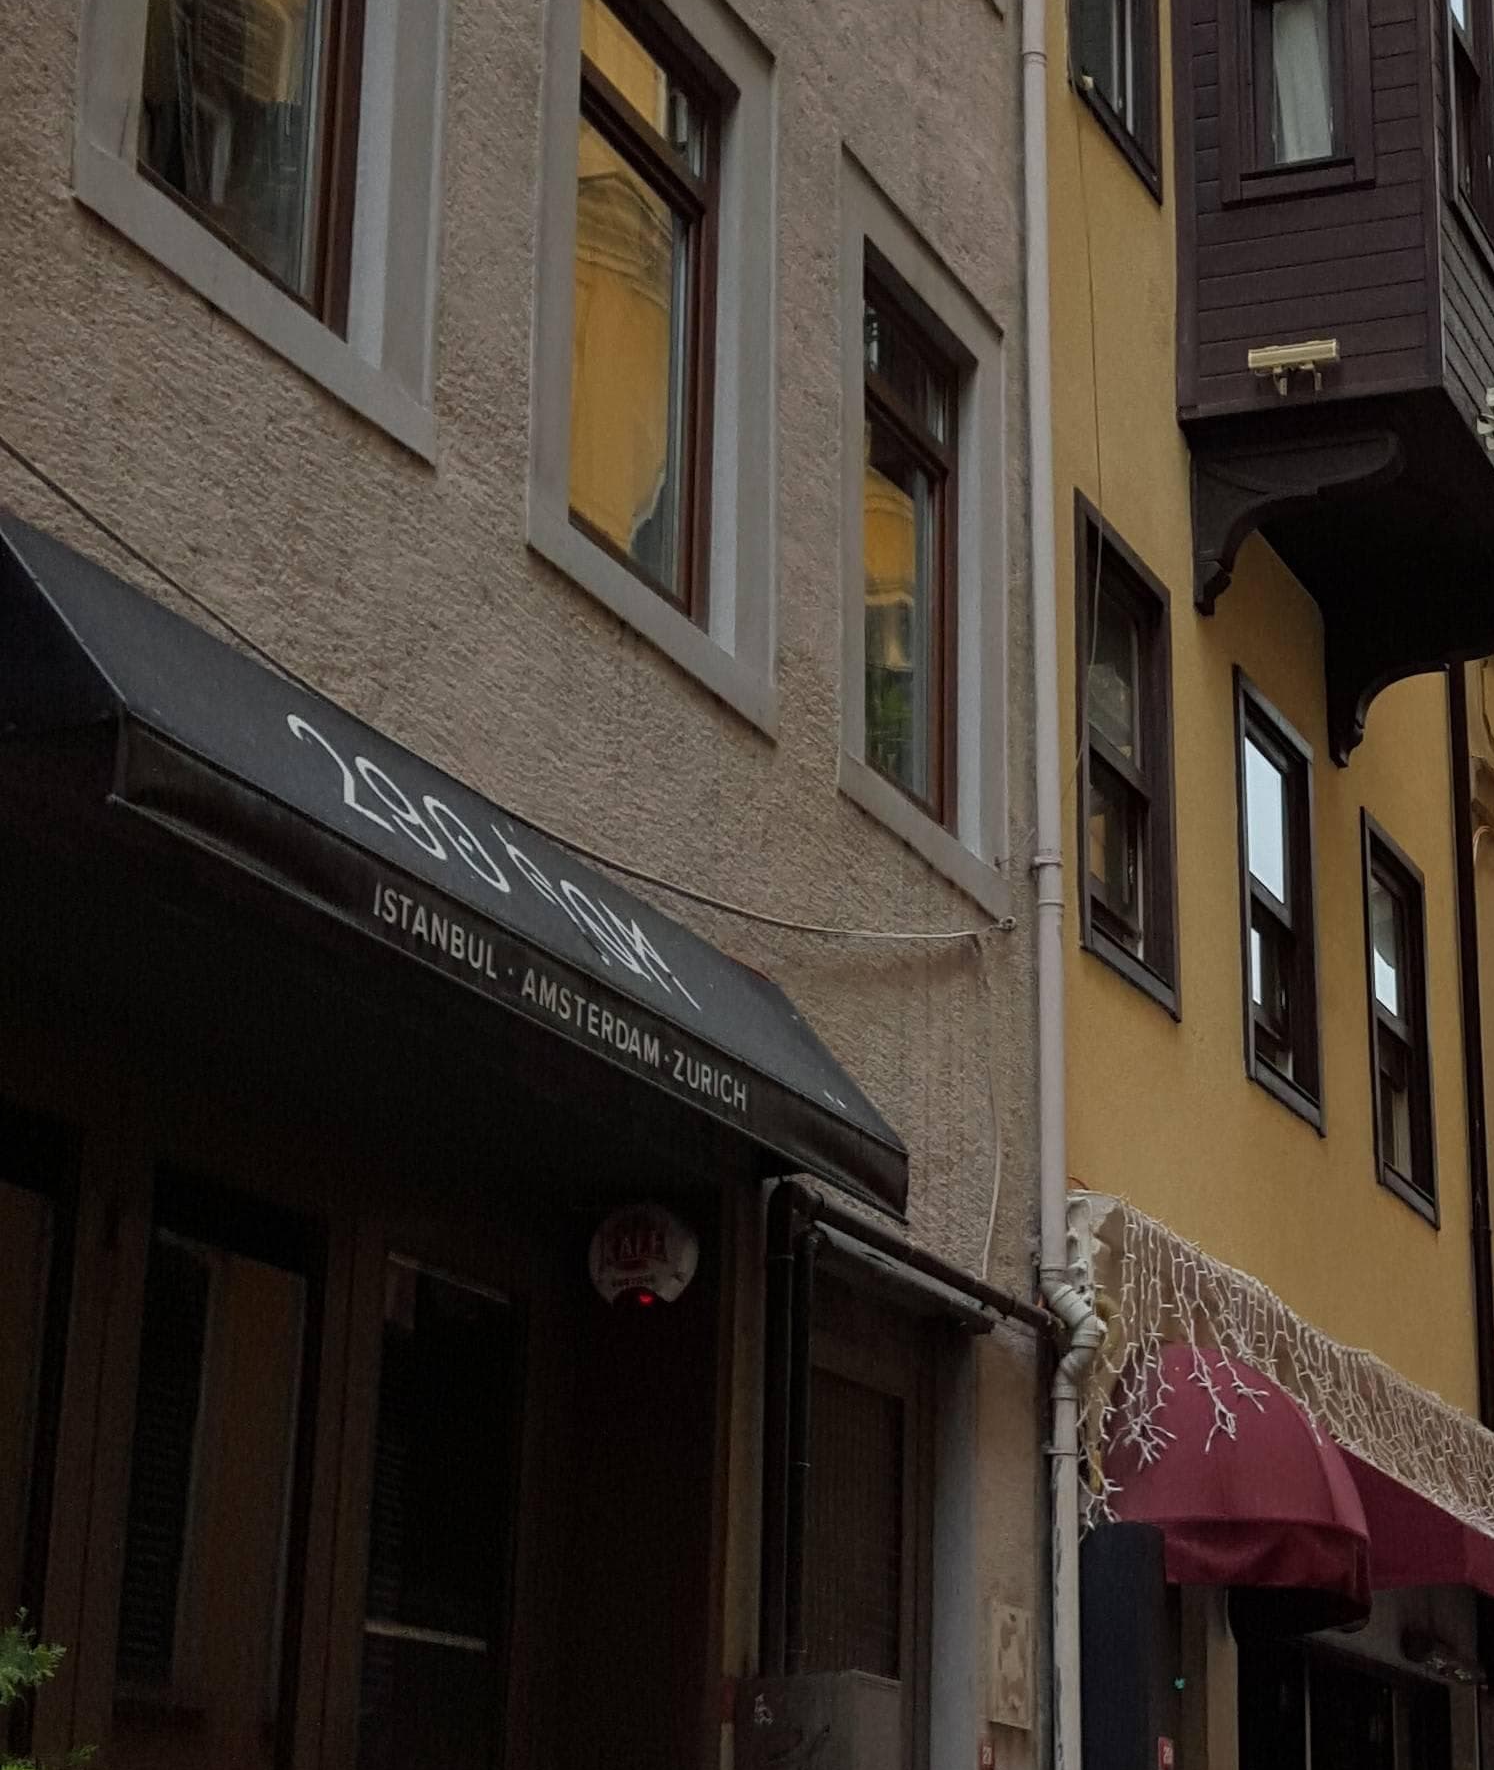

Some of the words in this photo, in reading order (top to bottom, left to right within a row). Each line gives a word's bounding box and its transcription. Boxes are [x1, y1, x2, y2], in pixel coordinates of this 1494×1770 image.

[286, 713, 510, 894] 290
[373, 882, 497, 981] ISTANBUL
[521, 967, 660, 1069] AMSTERDAM
[672, 1048, 749, 1113] ZURICH
